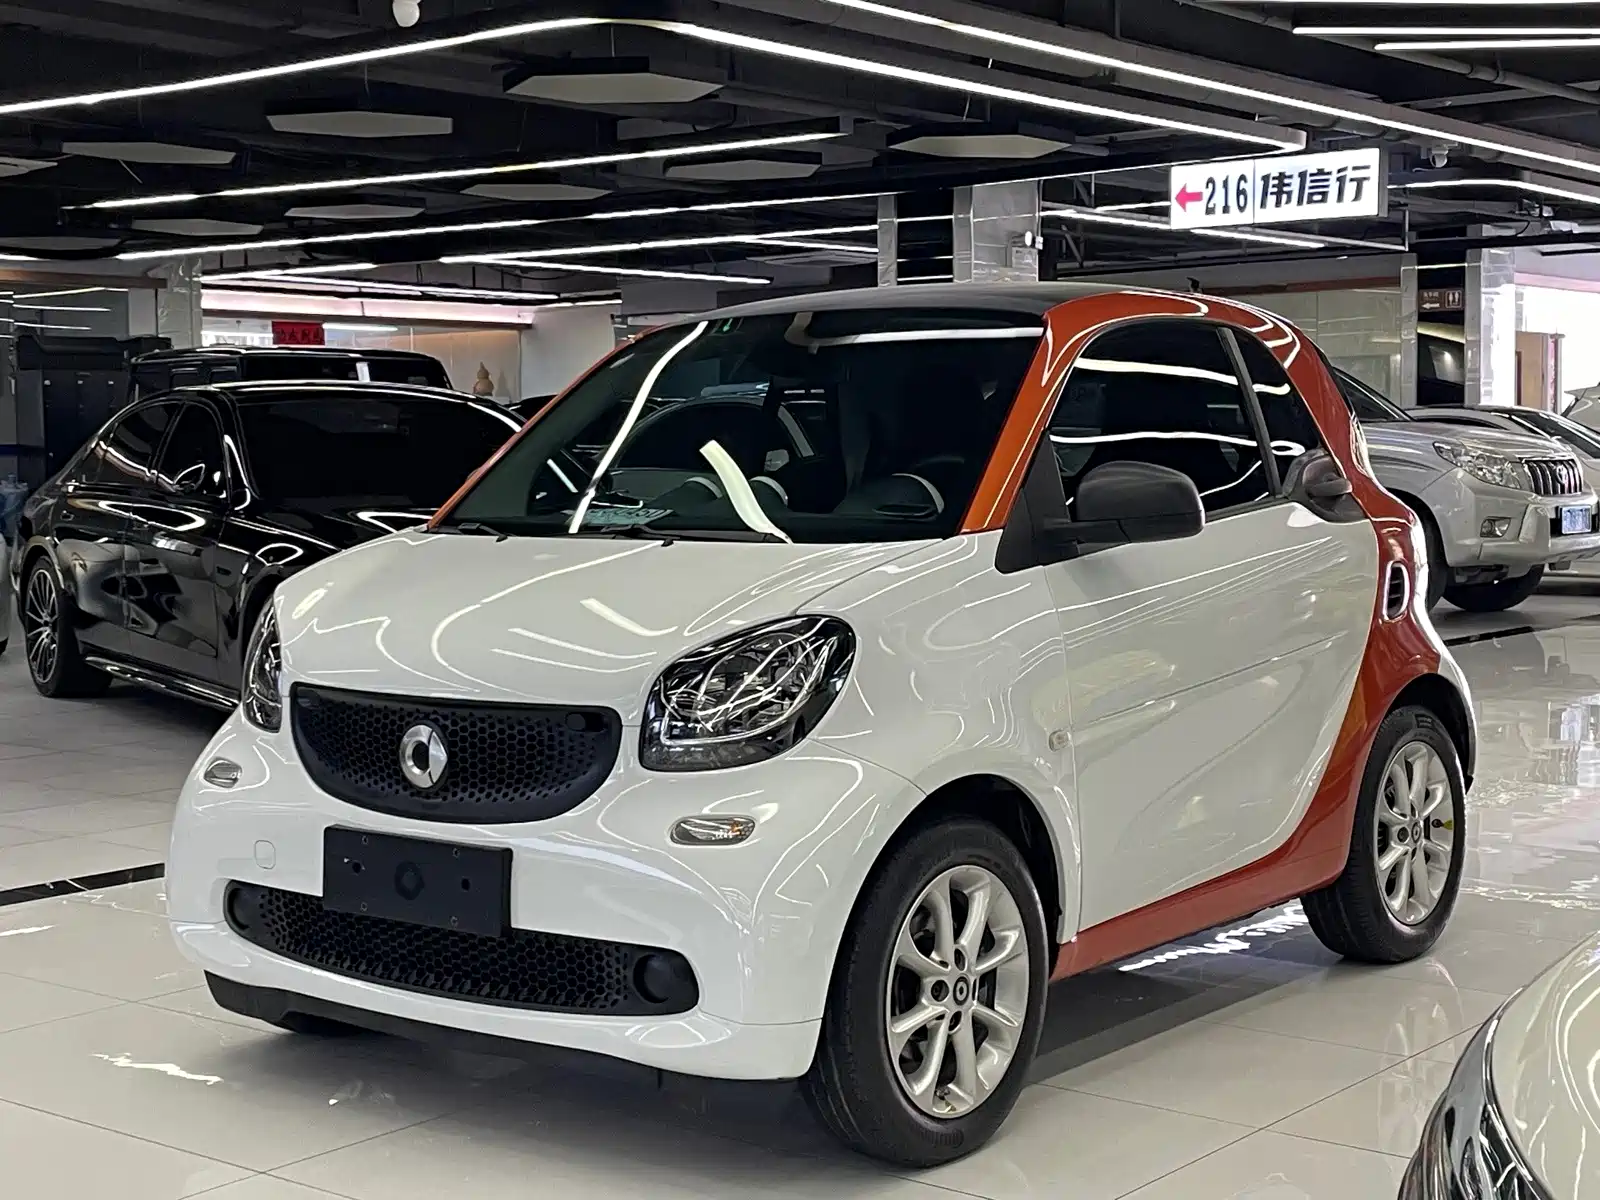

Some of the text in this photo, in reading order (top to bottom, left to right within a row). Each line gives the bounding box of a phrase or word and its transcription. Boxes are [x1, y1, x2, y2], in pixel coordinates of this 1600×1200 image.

[1205, 165, 1371, 215] 216 伟信行
